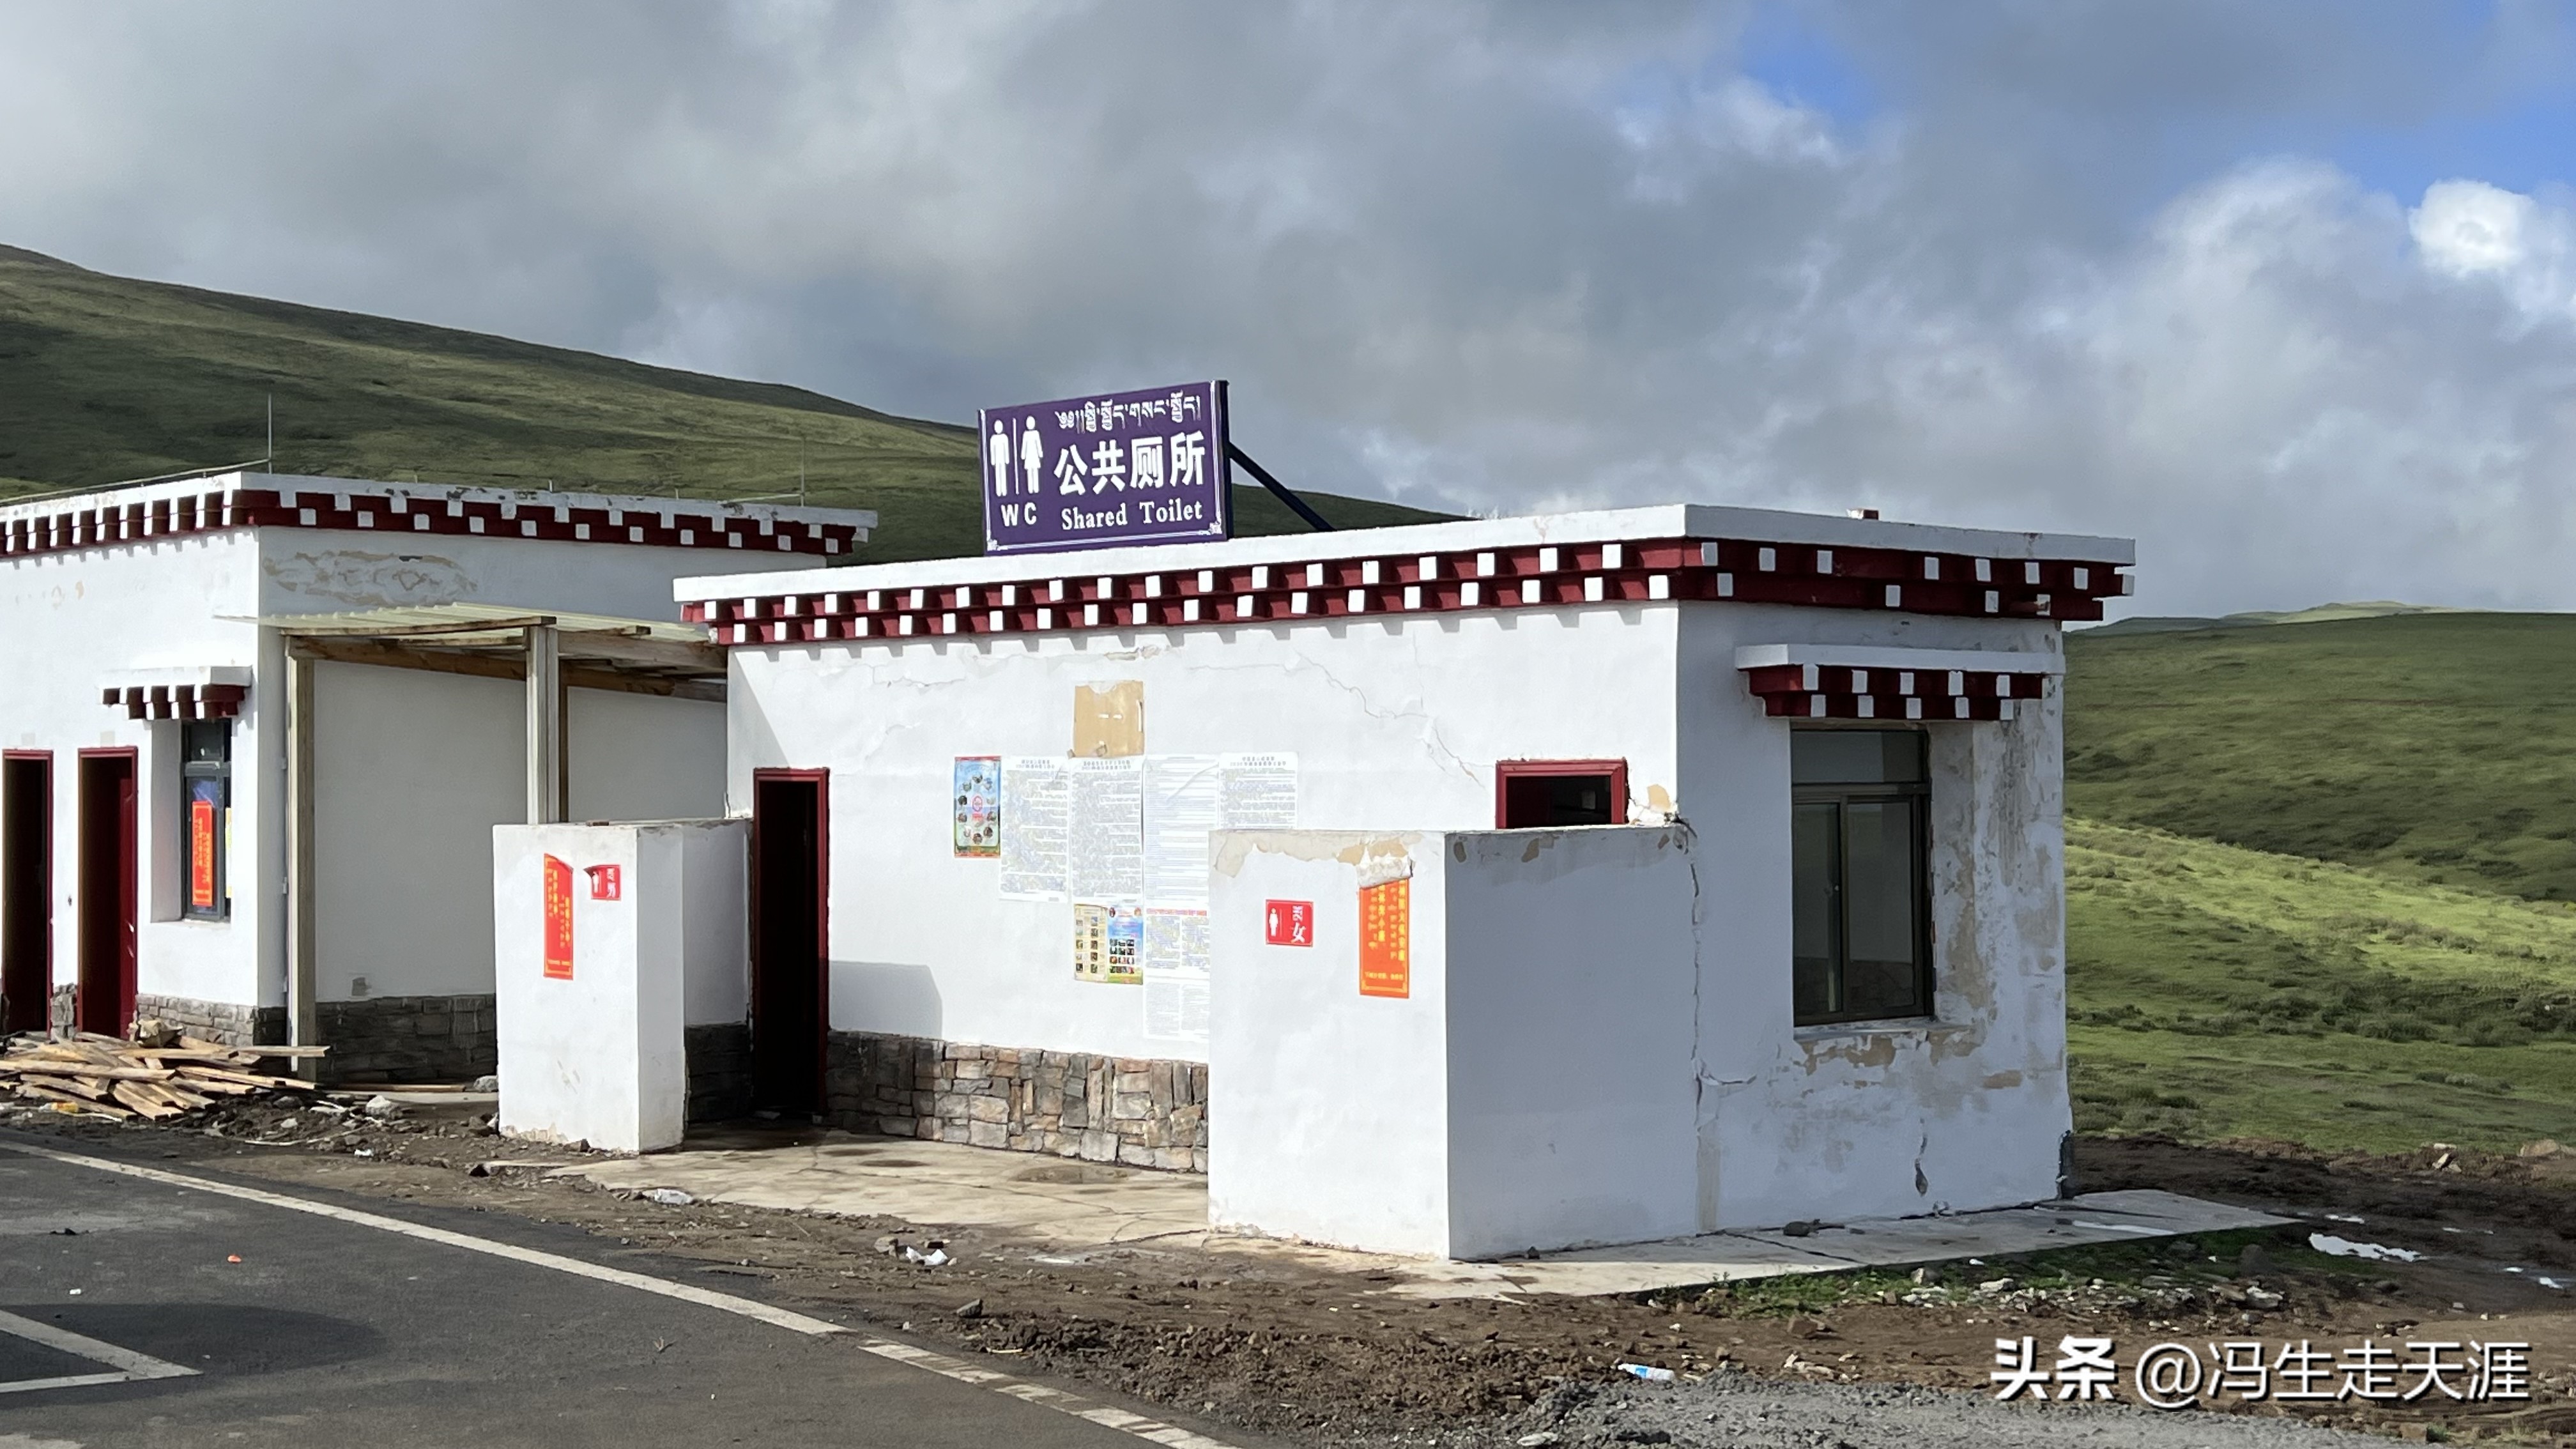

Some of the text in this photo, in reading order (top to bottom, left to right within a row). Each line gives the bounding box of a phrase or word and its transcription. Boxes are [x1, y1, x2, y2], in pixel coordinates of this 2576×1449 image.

[1054, 431, 1206, 496] 公共厕所
[1001, 503, 1038, 526] WC
[1061, 498, 1203, 530] Shared Toilet
[1291, 922, 1307, 943] 女
